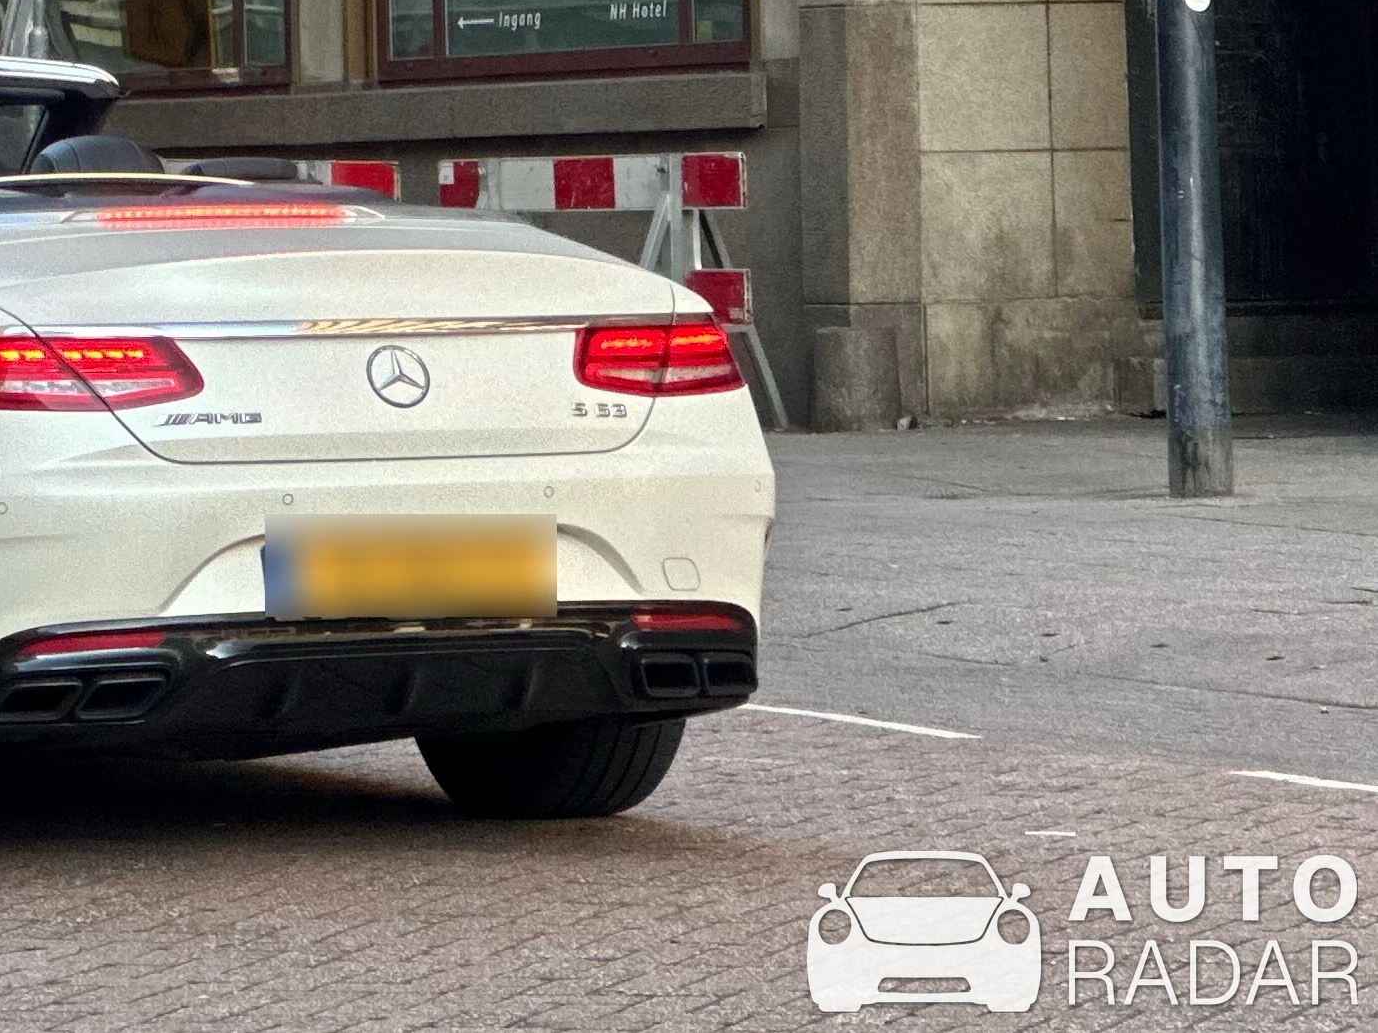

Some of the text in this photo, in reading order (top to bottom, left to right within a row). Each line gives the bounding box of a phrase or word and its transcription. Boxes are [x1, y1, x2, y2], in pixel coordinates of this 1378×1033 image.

[498, 0, 667, 31] Ingang NH Hotel
[571, 402, 588, 417] S
[189, 412, 262, 425] AMG
